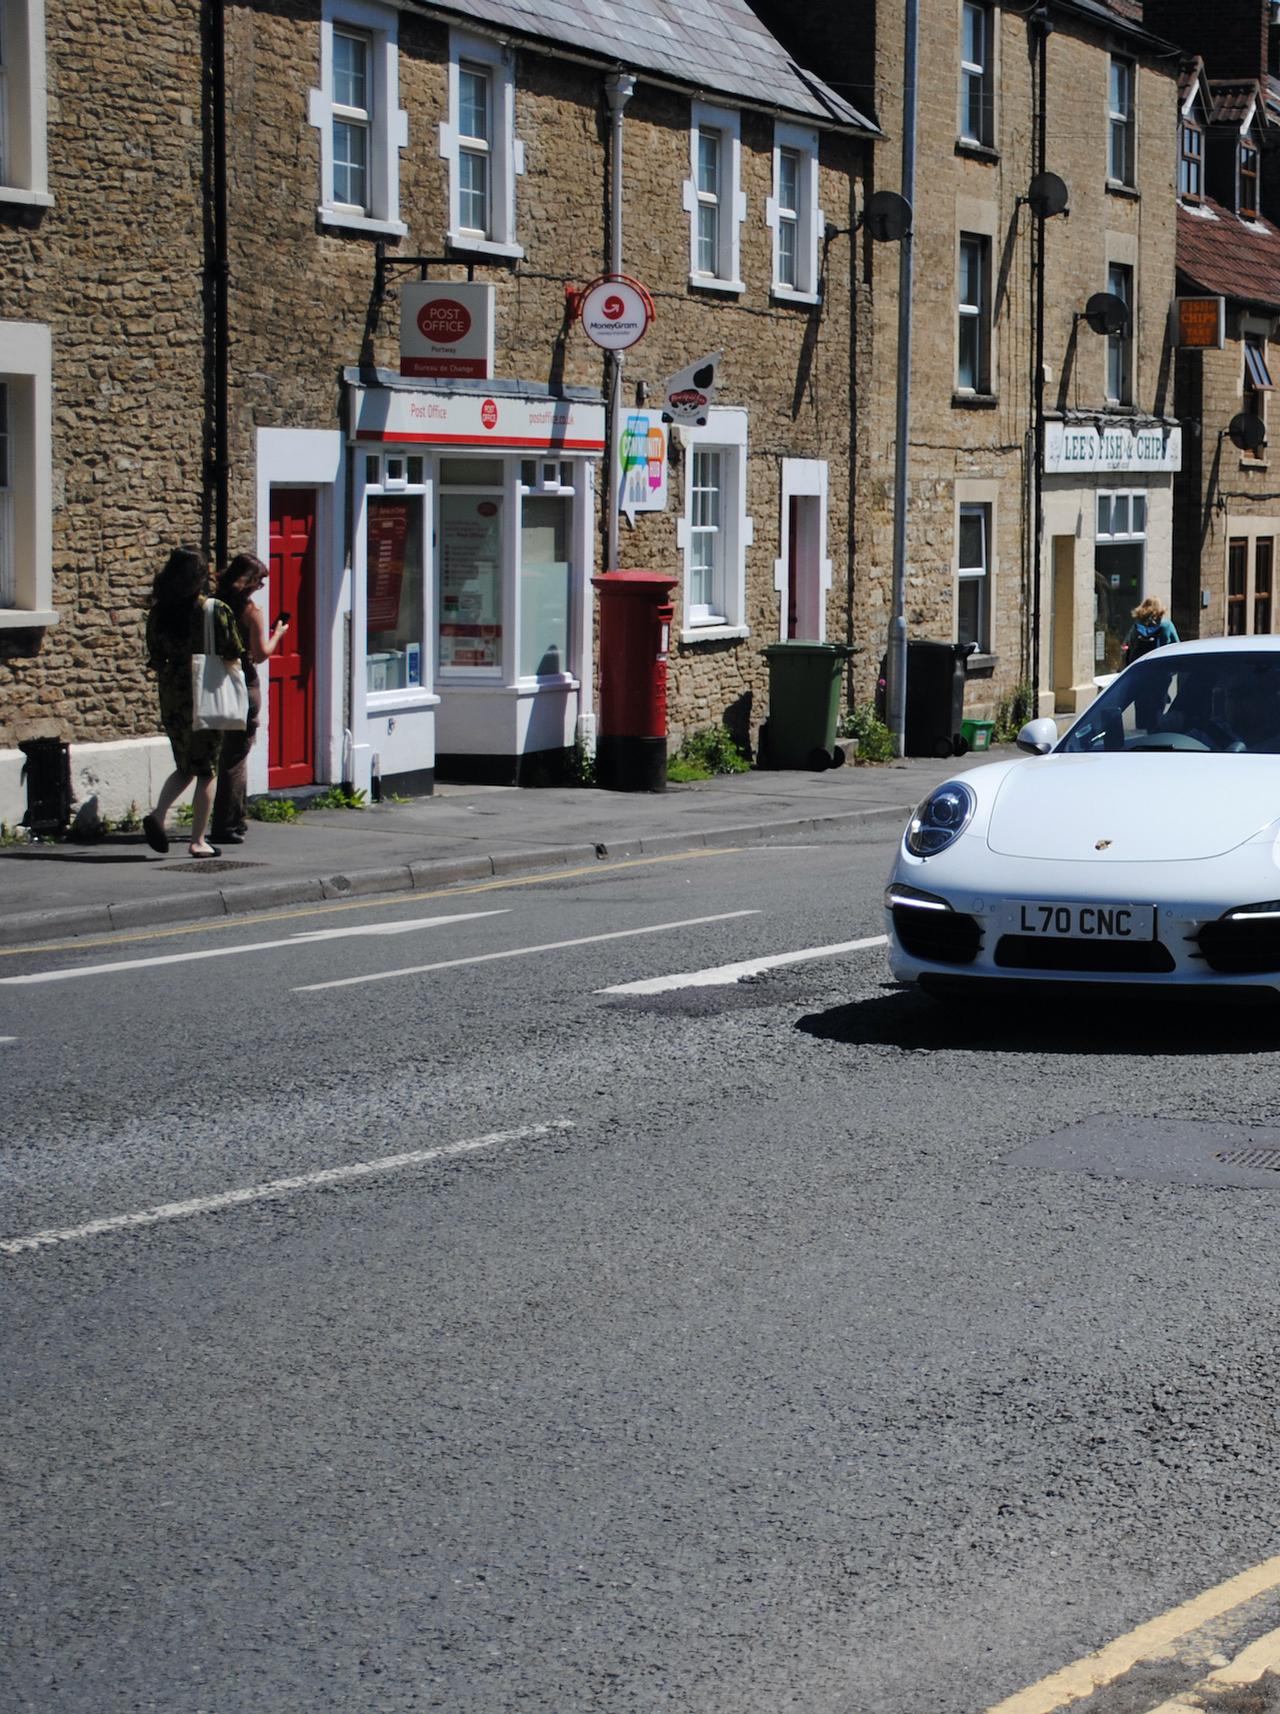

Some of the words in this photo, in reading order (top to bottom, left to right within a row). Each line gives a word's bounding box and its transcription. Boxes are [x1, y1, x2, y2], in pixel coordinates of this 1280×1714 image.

[1181, 301, 1209, 312] FISH
[430, 308, 460, 320] POST
[1181, 312, 1217, 323] CHIPS
[422, 320, 464, 332] OFFICE
[590, 322, 638, 331] MoneyGram
[1187, 328, 1212, 336] TAKE
[1186, 336, 1212, 345] AWAY
[431, 346, 457, 354] Portway
[414, 363, 438, 372] Bureau
[439, 364, 448, 372] de
[449, 364, 474, 374] Change
[411, 403, 426, 418] Post
[428, 404, 447, 420] Office
[484, 404, 495, 413] POST
[482, 412, 497, 423] OFFICE
[529, 411, 575, 426] postoffice.co.uk
[622, 436, 662, 457] COMMUNITY
[1065, 435, 1094, 460] LEE'S
[1099, 436, 1123, 460] FISH
[1127, 436, 1134, 460] &
[1137, 436, 1167, 460] CHIPS
[649, 460, 661, 478] HUB
[1020, 905, 1071, 934] L70
[1079, 908, 1132, 937] CNC
